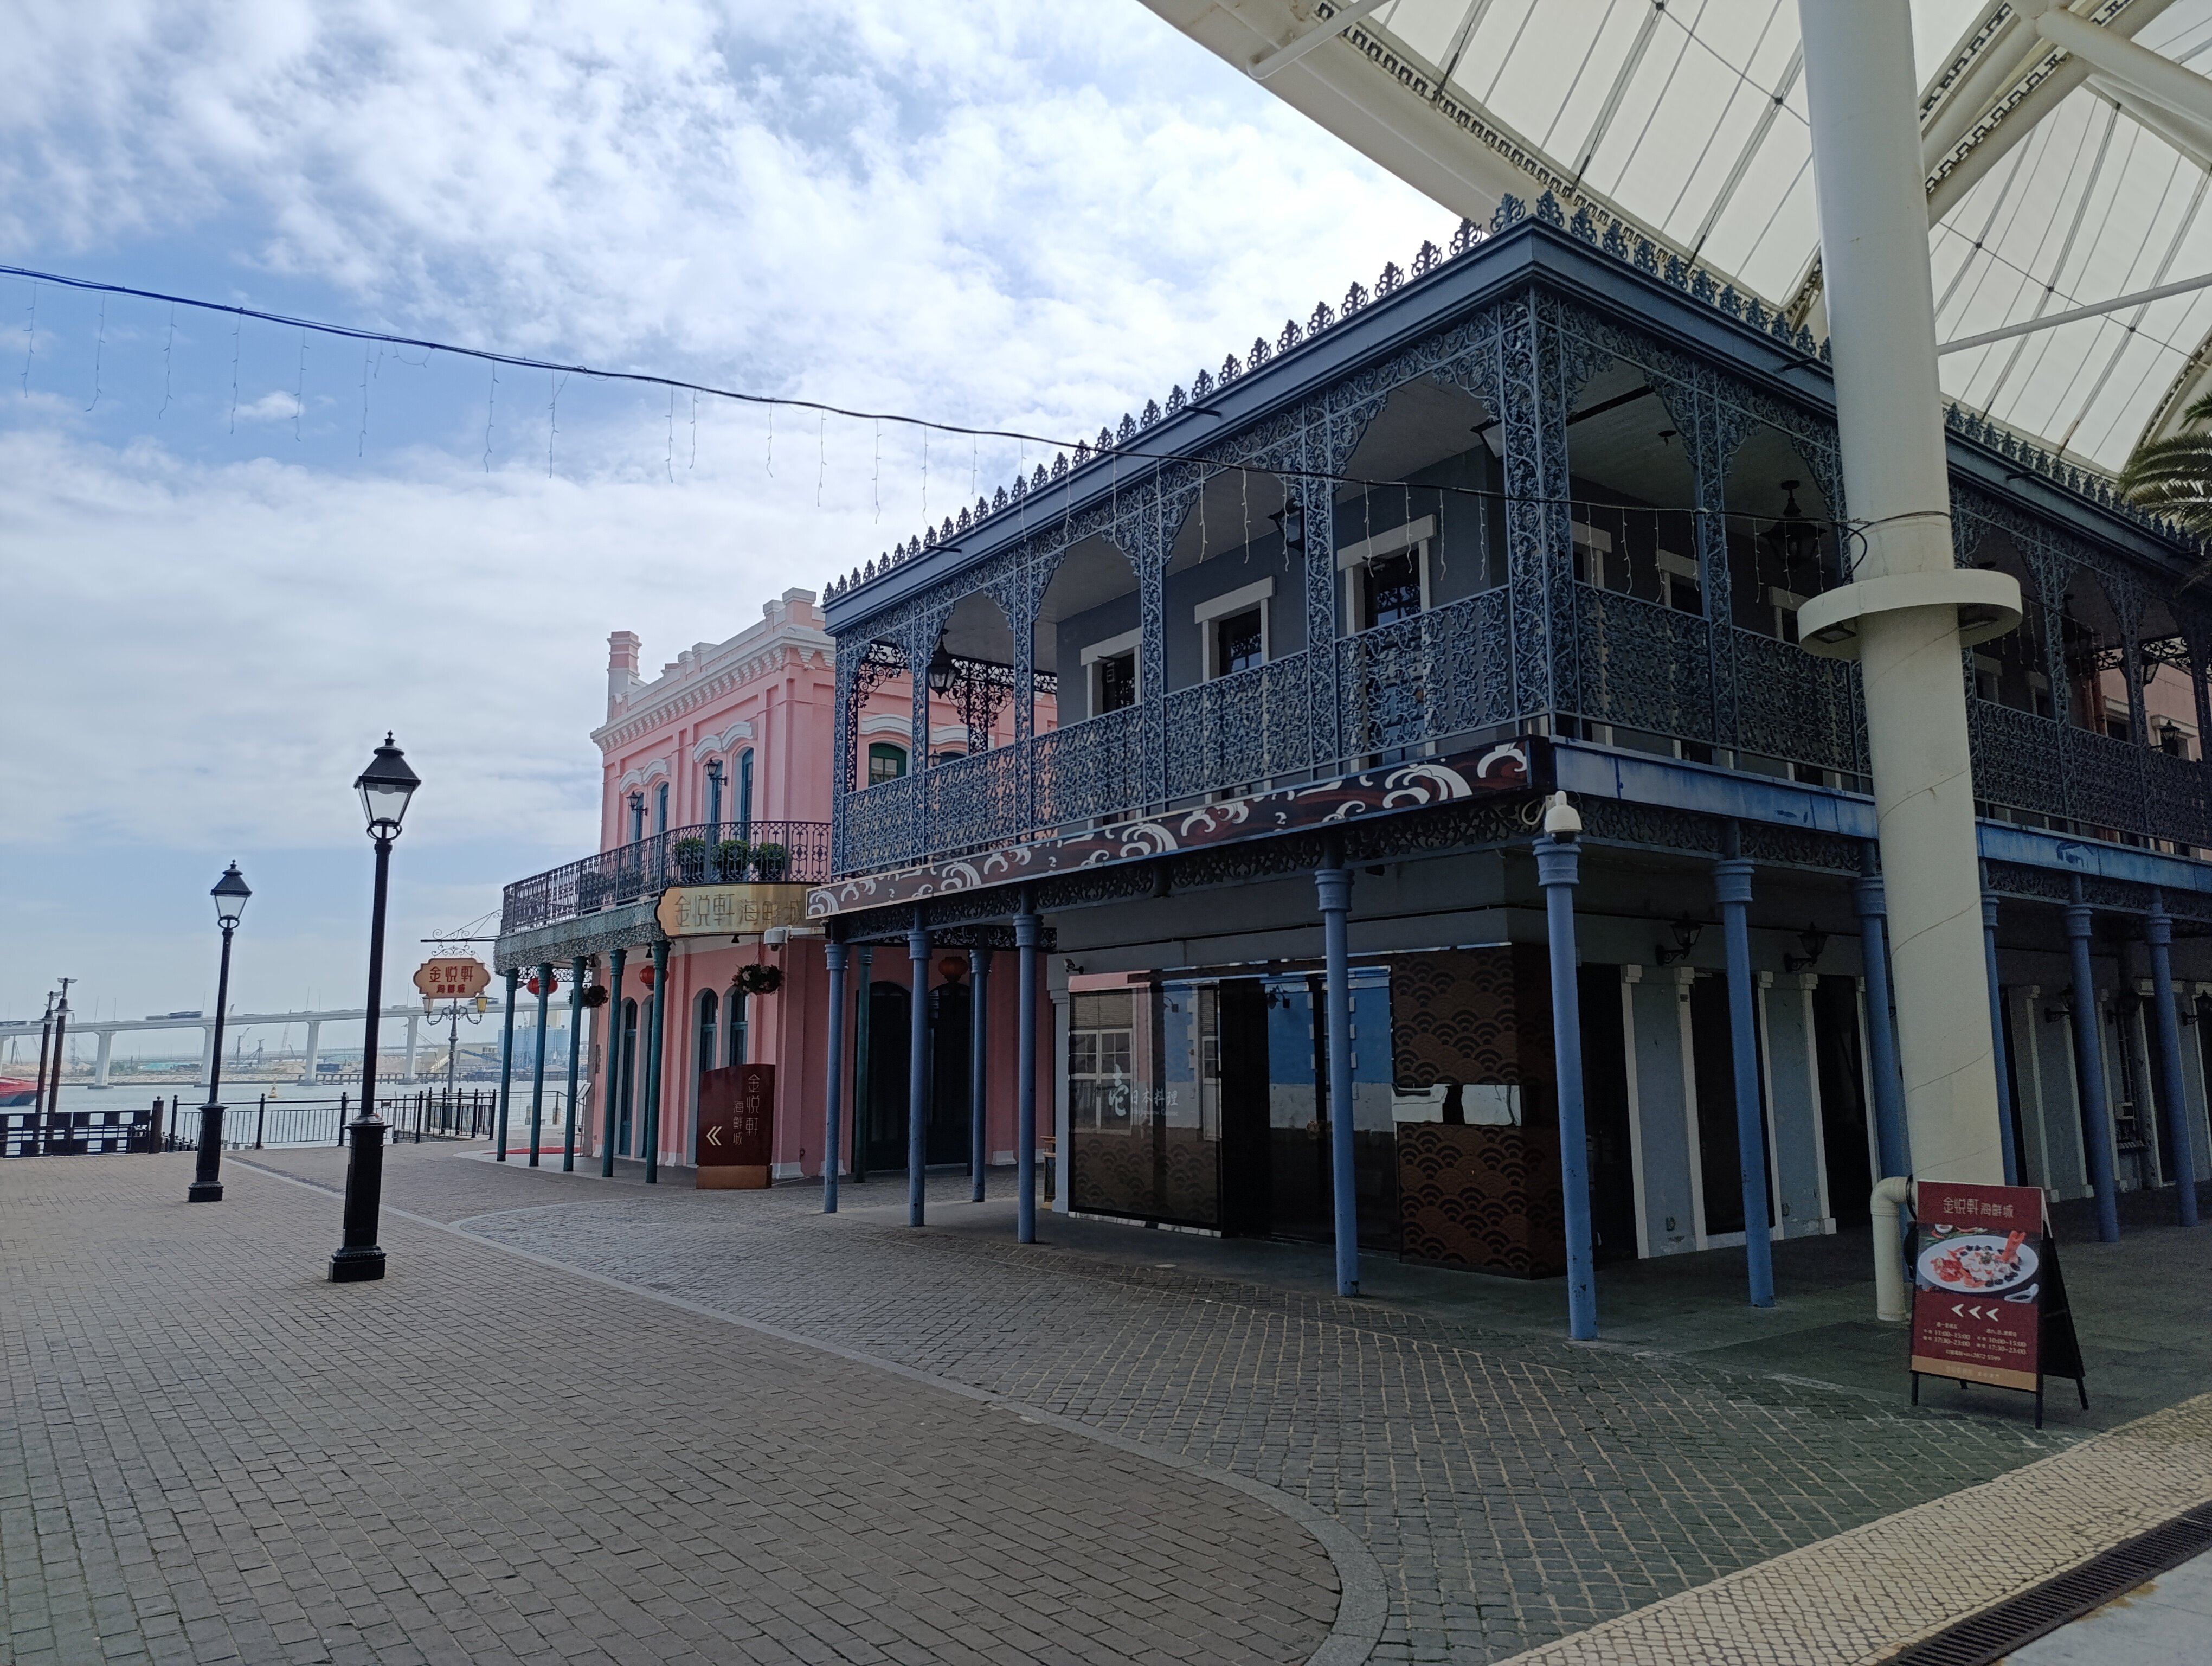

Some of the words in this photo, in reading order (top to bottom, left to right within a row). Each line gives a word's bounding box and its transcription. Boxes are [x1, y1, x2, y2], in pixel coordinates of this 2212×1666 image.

[1130, 1088, 1179, 1107] 日本料理
[733, 1100, 744, 1146] 海鮮城
